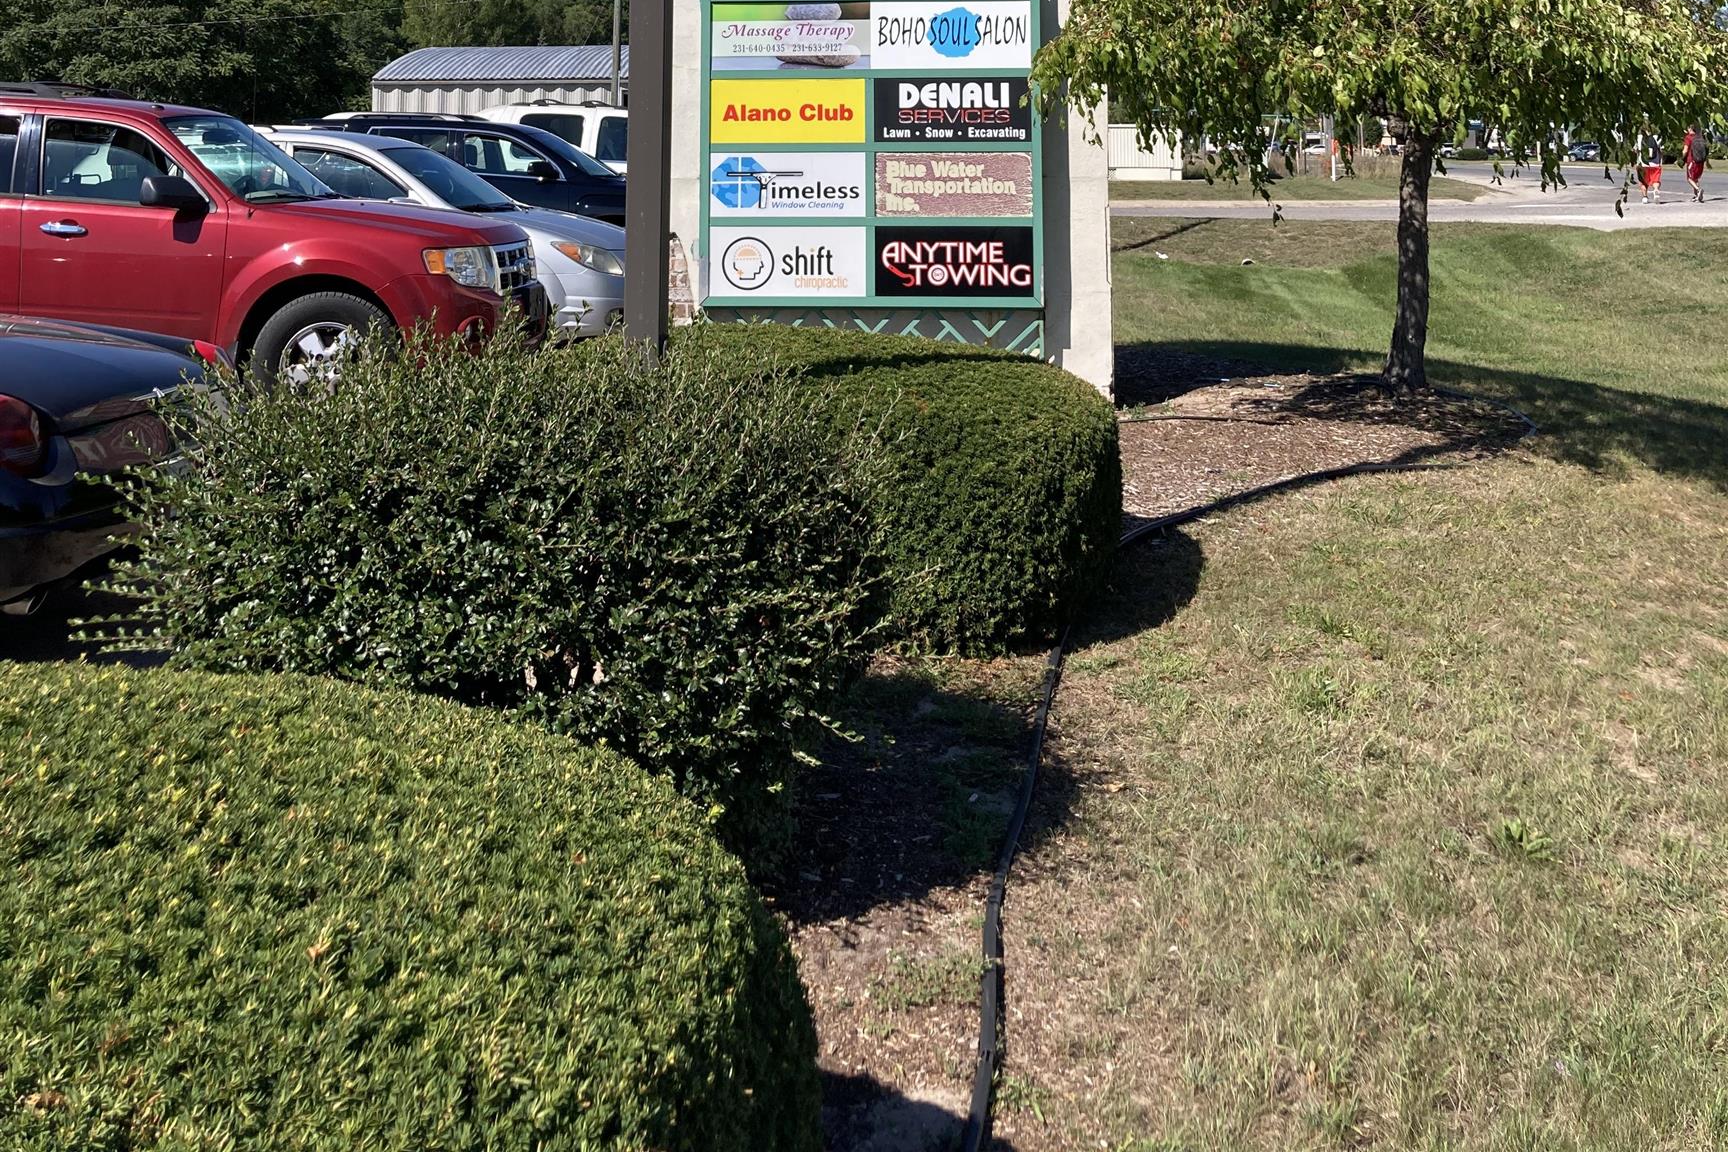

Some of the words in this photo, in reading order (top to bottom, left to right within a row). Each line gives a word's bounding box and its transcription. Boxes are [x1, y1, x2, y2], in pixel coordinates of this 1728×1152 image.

[721, 24, 791, 41] Massage
[795, 22, 854, 41] Therapy
[898, 82, 1010, 108] DENALI
[722, 104, 792, 122] Alano
[798, 103, 854, 122] Club
[898, 108, 1011, 124] SERVICES
[883, 126, 911, 138] Lawn
[925, 126, 954, 138] Snow
[967, 126, 1026, 140] Excavating
[886, 160, 927, 178] Blue
[931, 160, 985, 178] Water
[888, 177, 1017, 198] Transportation
[771, 201, 806, 209] Window
[807, 201, 845, 210] Cleaning
[781, 245, 834, 276] shift
[881, 241, 1004, 264] ANYTIME
[794, 276, 849, 291] chiropractic
[908, 264, 1032, 287] TOWING
